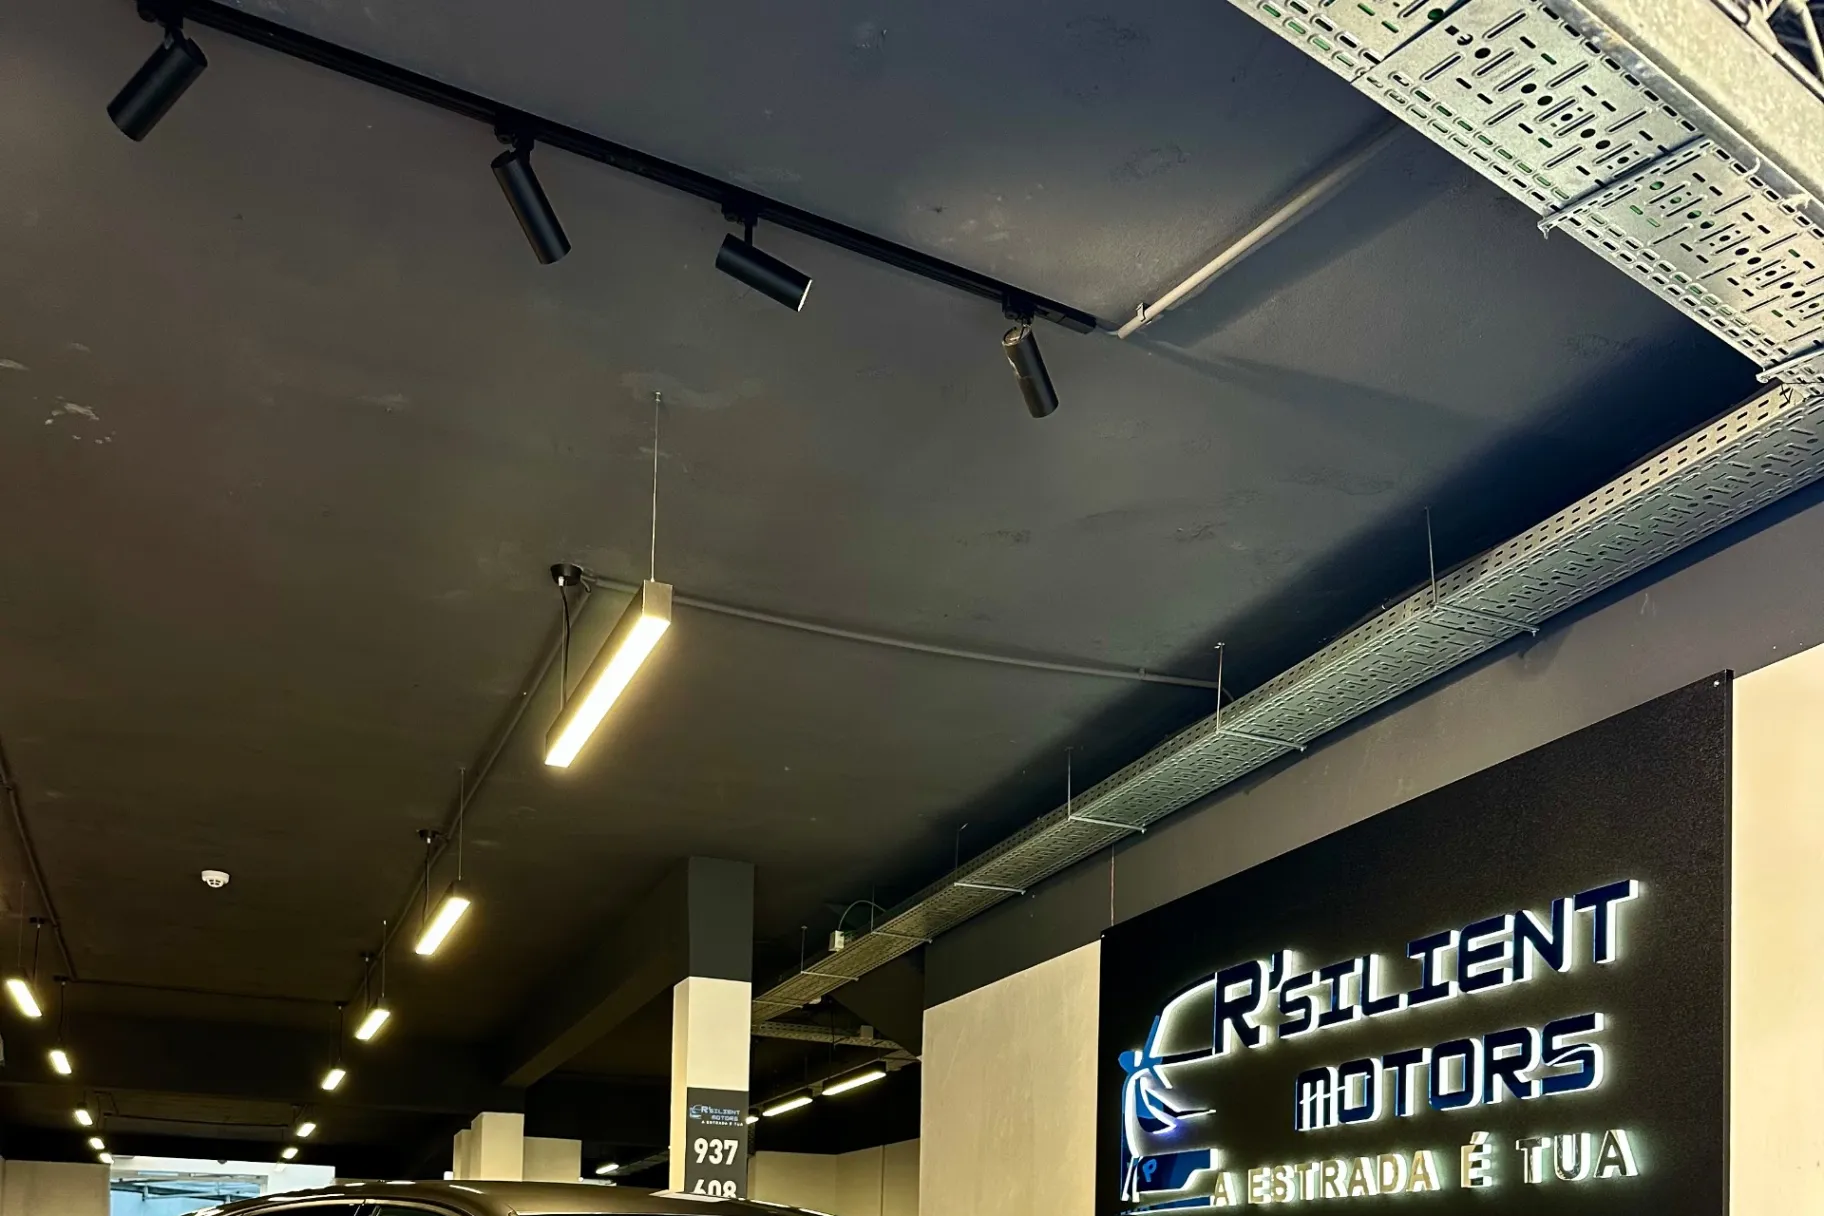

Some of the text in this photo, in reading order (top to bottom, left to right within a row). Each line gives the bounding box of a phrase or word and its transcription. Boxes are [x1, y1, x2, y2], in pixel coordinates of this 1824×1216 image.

[1214, 879, 1639, 1056] R'SILIENT
[1295, 1012, 1604, 1131] MOTORS
[694, 1137, 738, 1165] 937
[1213, 1129, 1639, 1206] A ESTRADA É TUA
